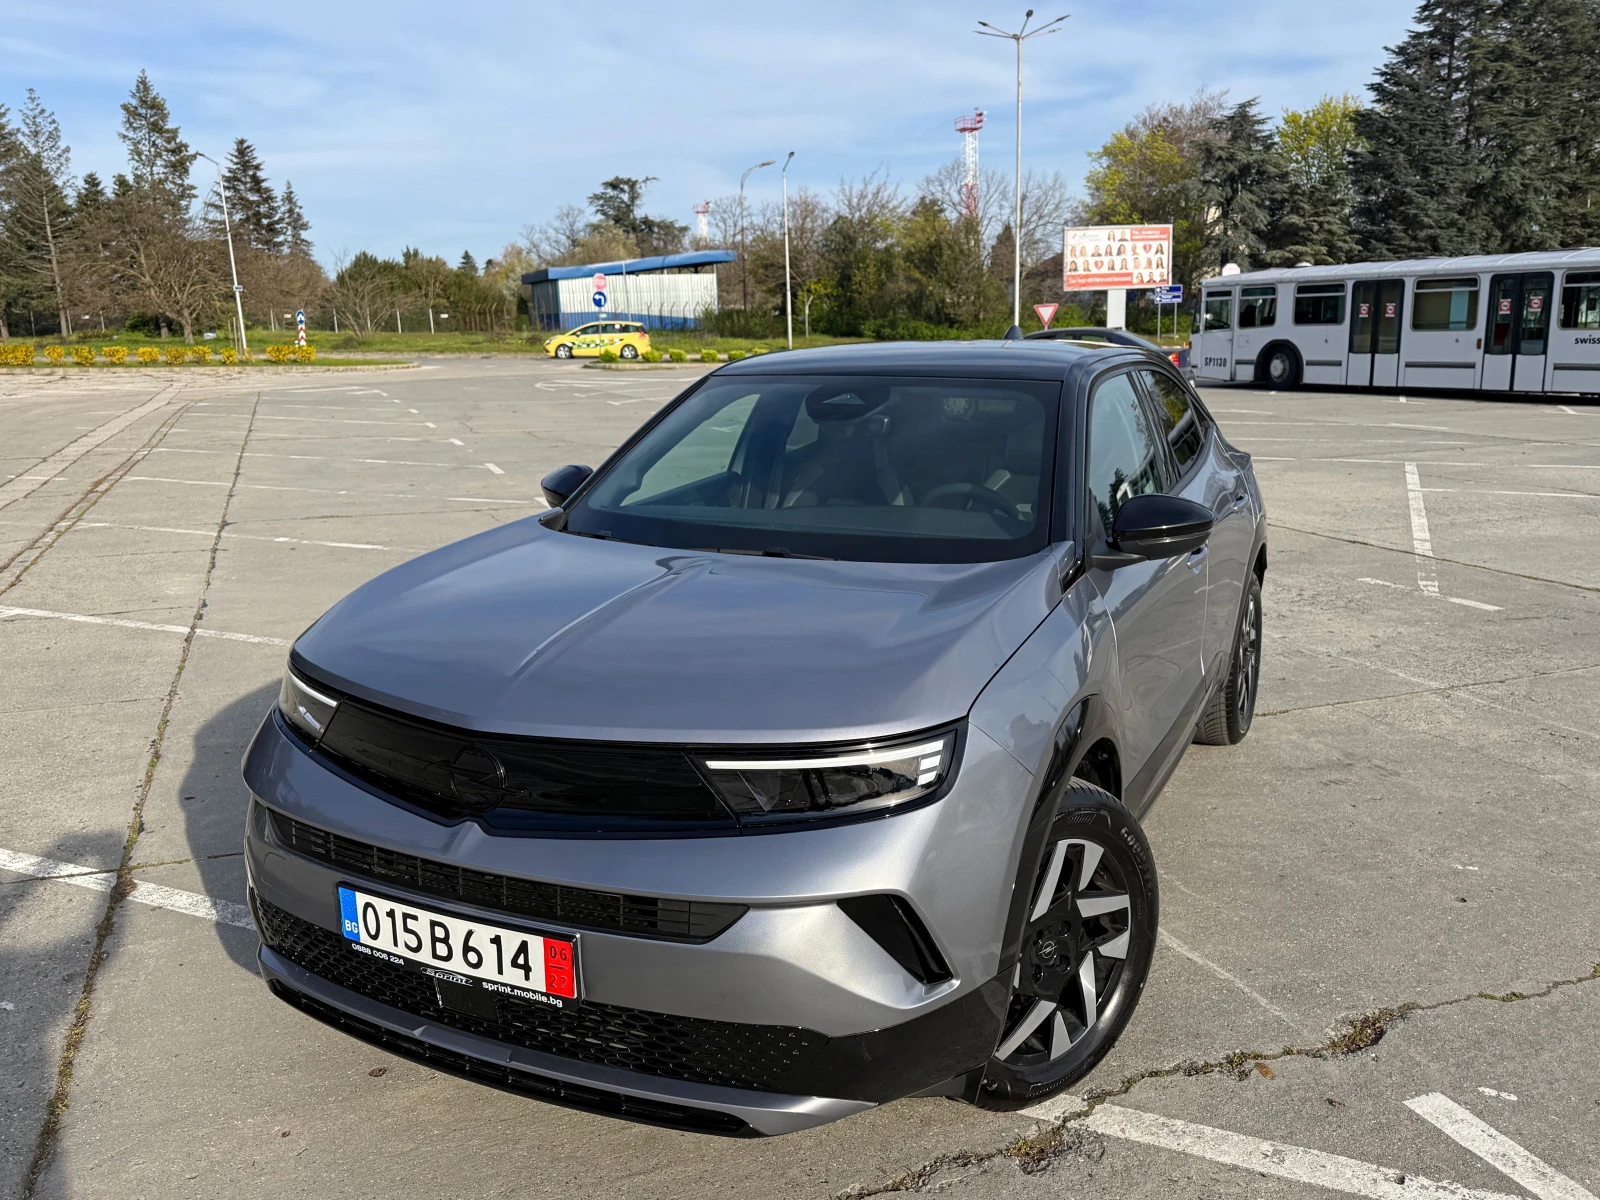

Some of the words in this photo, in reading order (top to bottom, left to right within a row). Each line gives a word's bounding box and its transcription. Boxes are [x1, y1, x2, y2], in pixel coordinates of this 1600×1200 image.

[1204, 356, 1227, 368] SP1130
[344, 919, 359, 934] BG
[362, 900, 533, 982] 015B614
[549, 945, 568, 961] 06
[549, 973, 568, 989] 27
[482, 981, 563, 1008] sprint.mobile.bg
